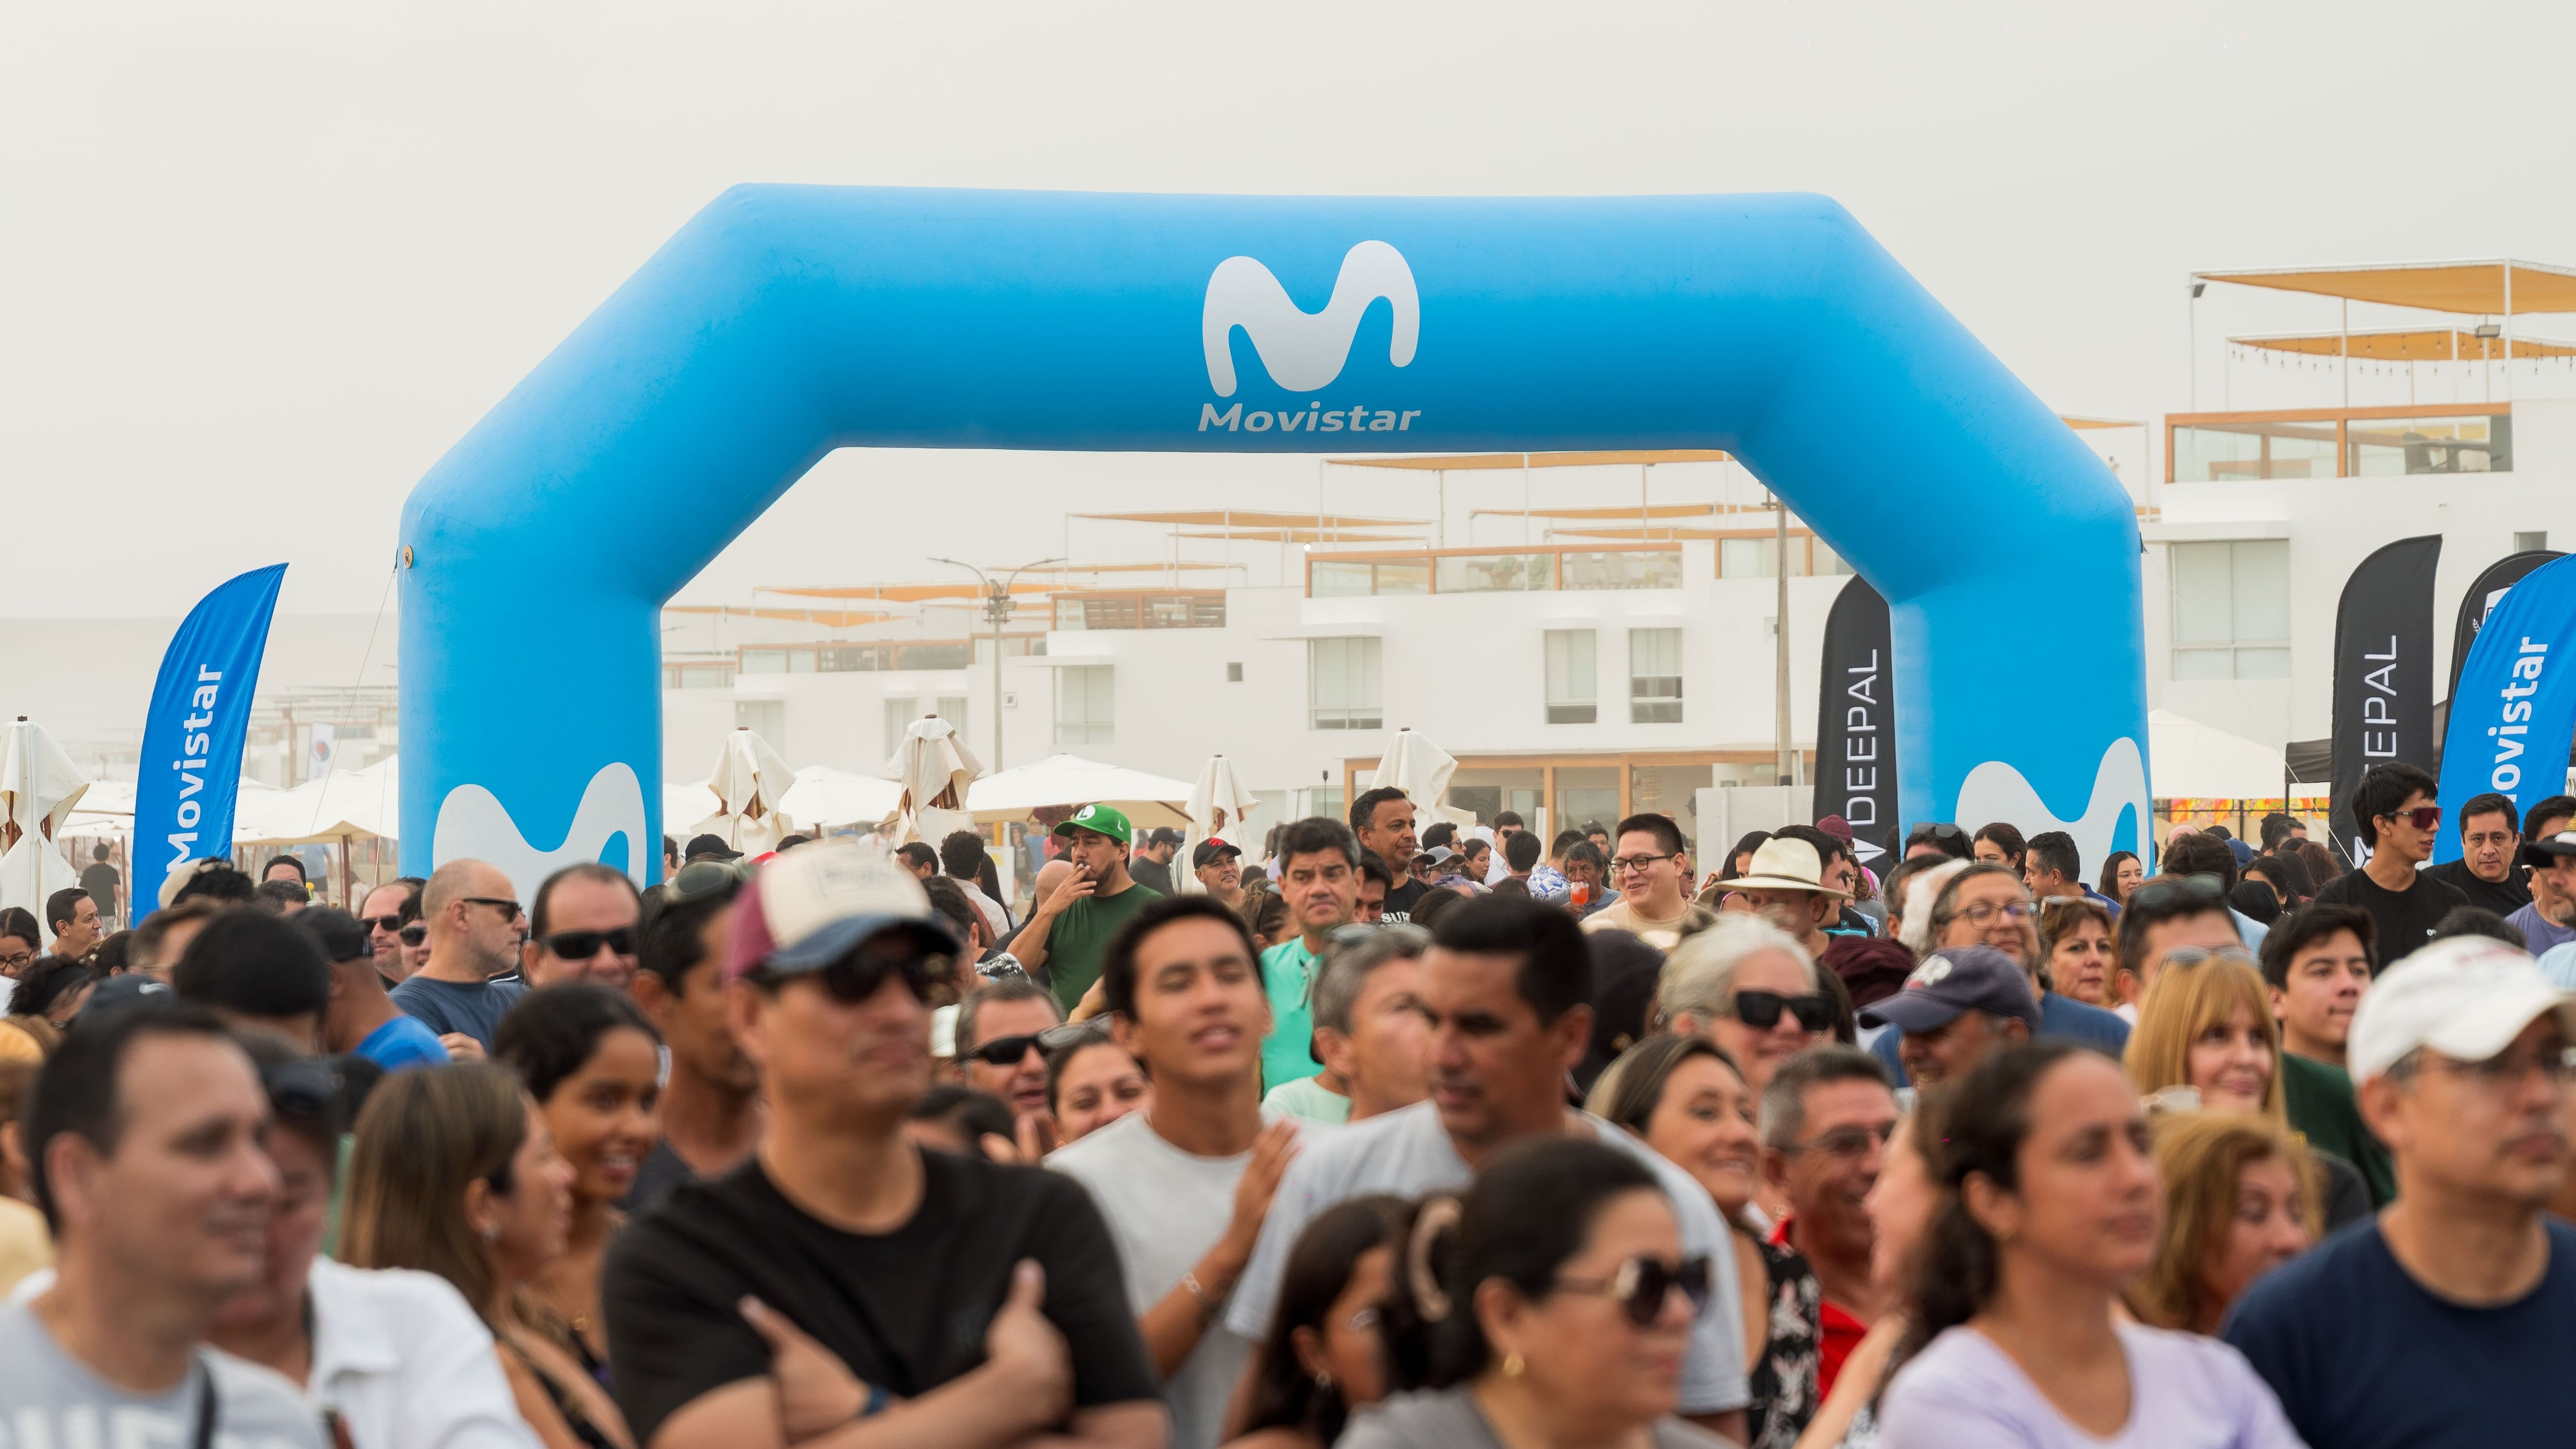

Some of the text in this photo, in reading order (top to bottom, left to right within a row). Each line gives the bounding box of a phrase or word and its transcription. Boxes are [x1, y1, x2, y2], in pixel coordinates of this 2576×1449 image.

[1198, 401, 1421, 432] Movistar
[166, 664, 222, 873] Movistar
[1846, 649, 1877, 825] DEEPAL
[2364, 635, 2397, 773] EPAL
[2487, 636, 2548, 803] ovistar
